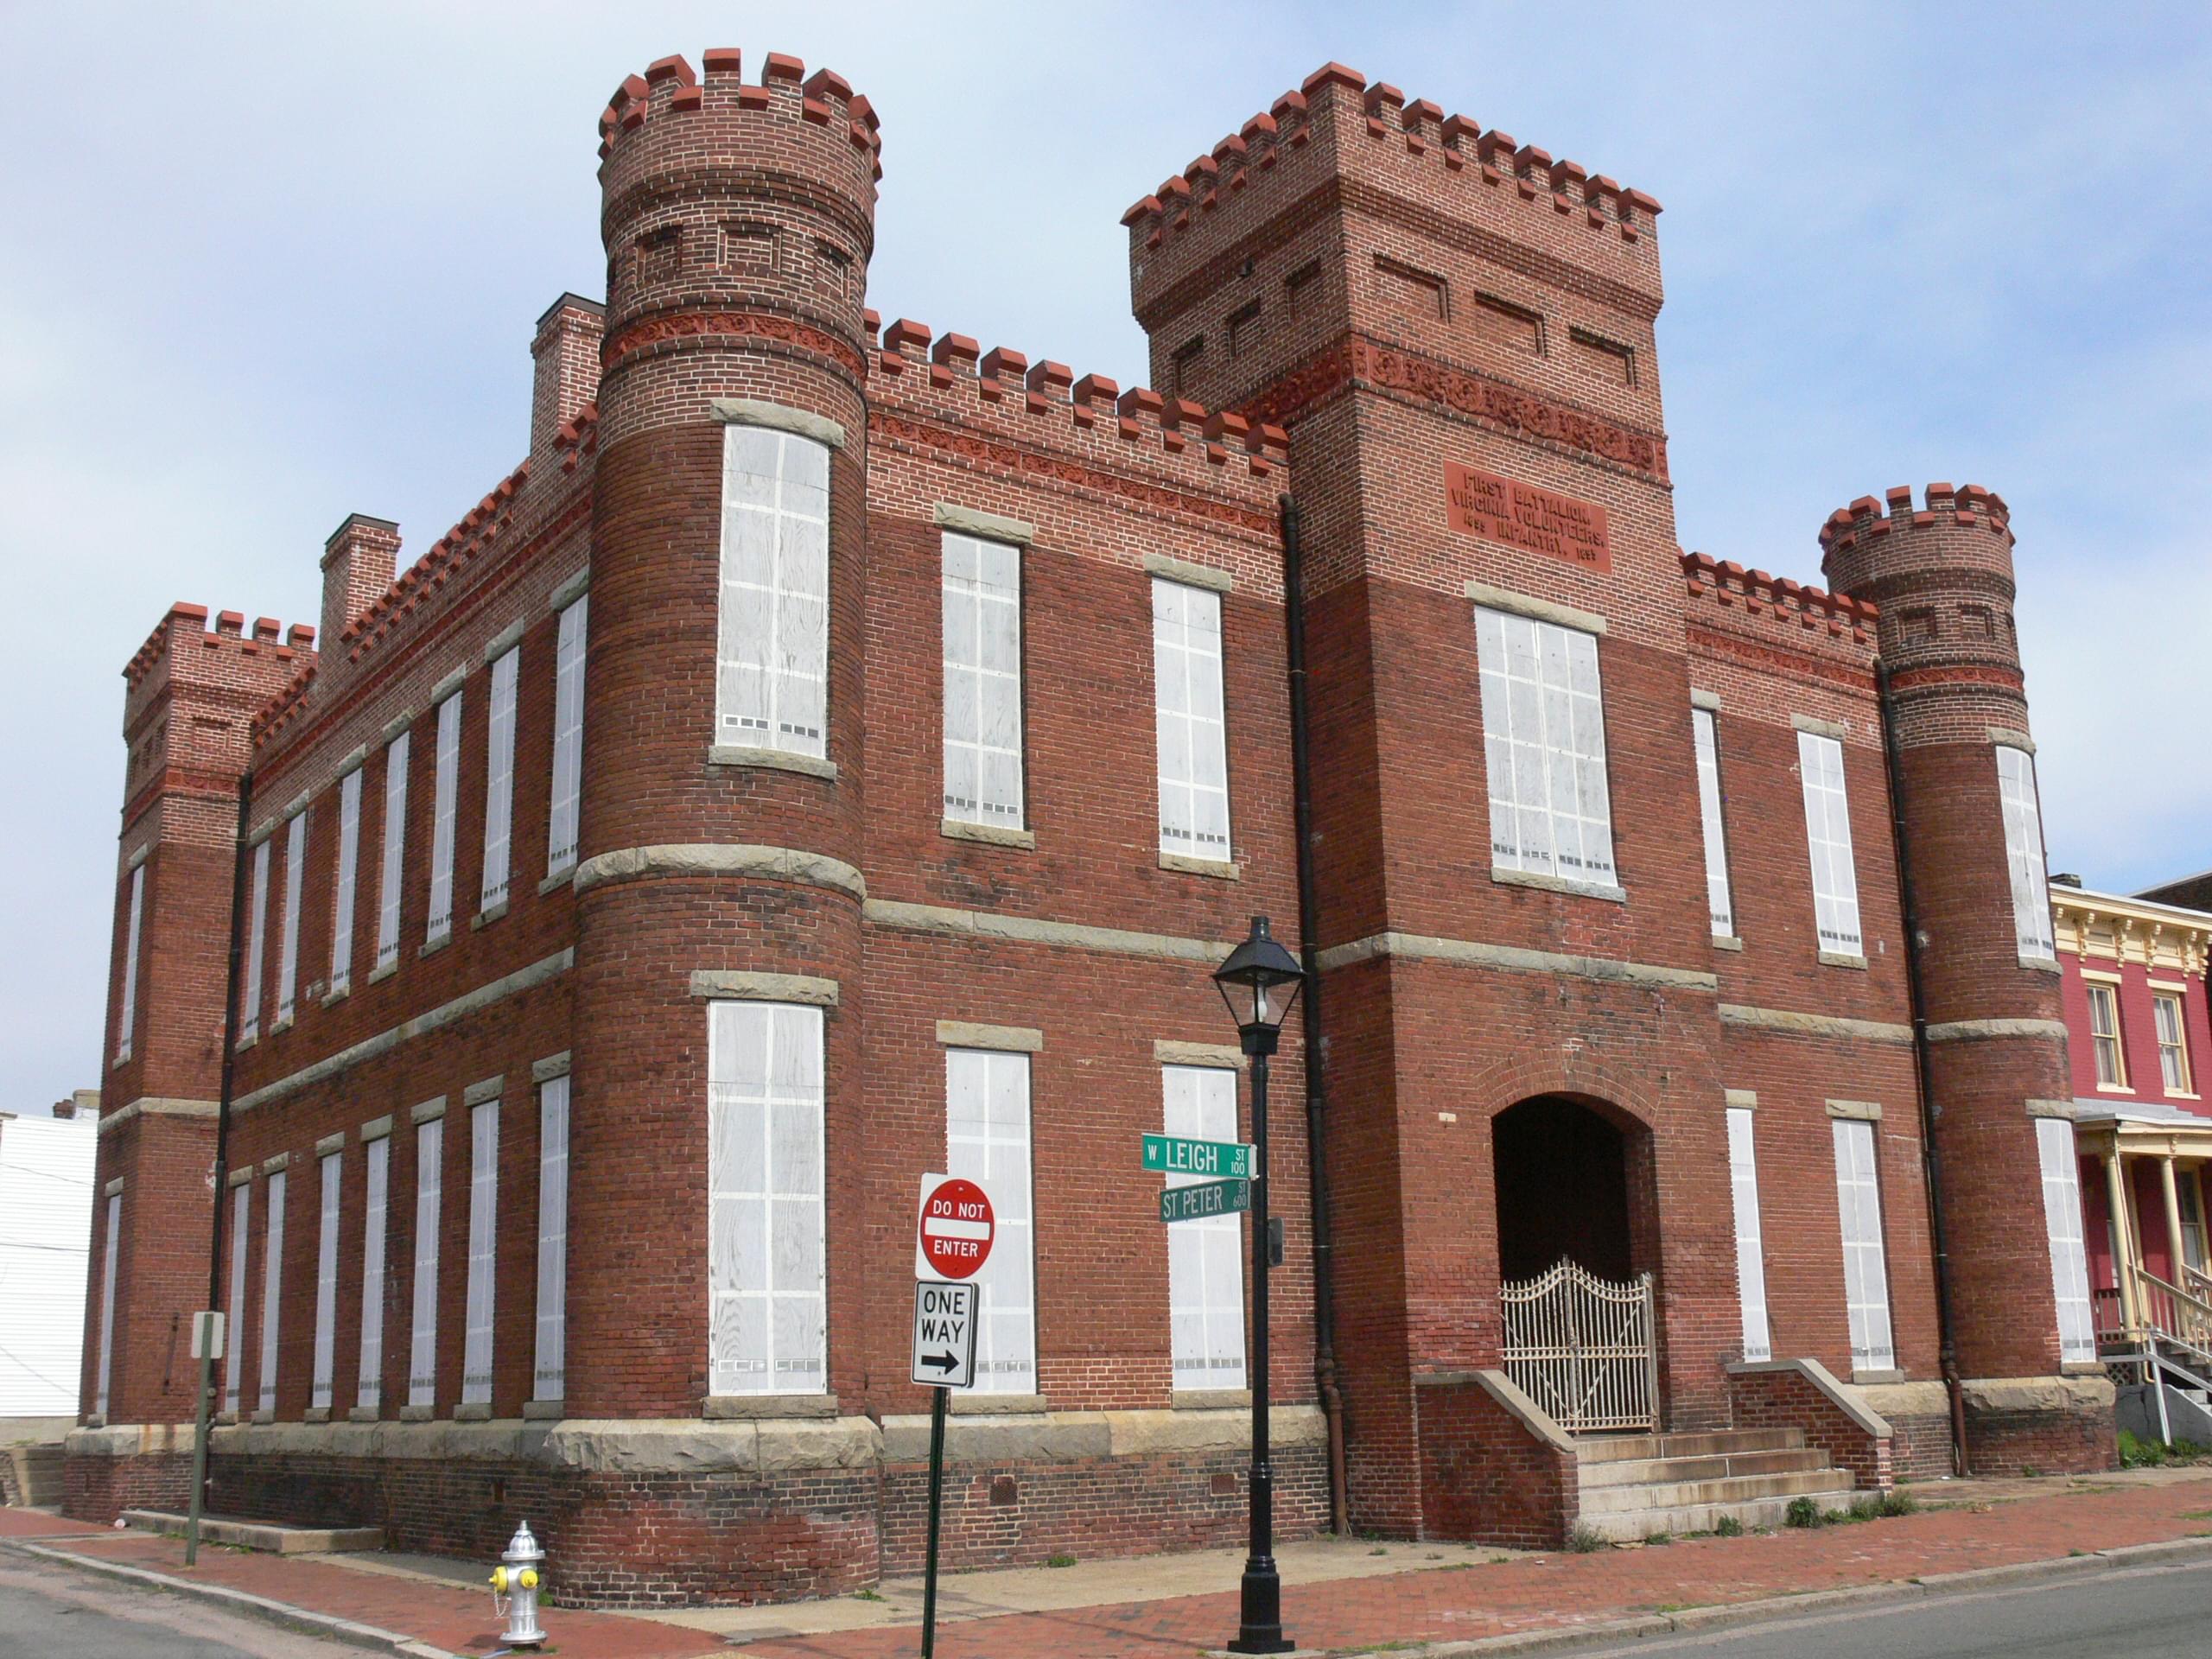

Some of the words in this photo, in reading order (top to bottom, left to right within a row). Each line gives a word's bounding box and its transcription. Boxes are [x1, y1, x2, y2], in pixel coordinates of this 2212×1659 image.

[1463, 473, 1506, 499] FIRST
[1452, 488, 1510, 520] VIRGINIA
[1147, 1144, 1157, 1160] W
[1166, 1141, 1217, 1172] LEIGH
[1235, 1148, 1245, 1161] ST
[1230, 1161, 1245, 1174] 100
[933, 1199, 951, 1216] DO
[958, 1202, 985, 1218] NOT
[1163, 1192, 1178, 1218] ST
[1183, 1185, 1223, 1216] PETER
[1238, 1181, 1246, 1193] ST
[1233, 1194, 1247, 1207] 600
[934, 1239, 978, 1257] ENTER
[924, 1290, 965, 1315] ONE
[922, 1319, 965, 1344] WAY
